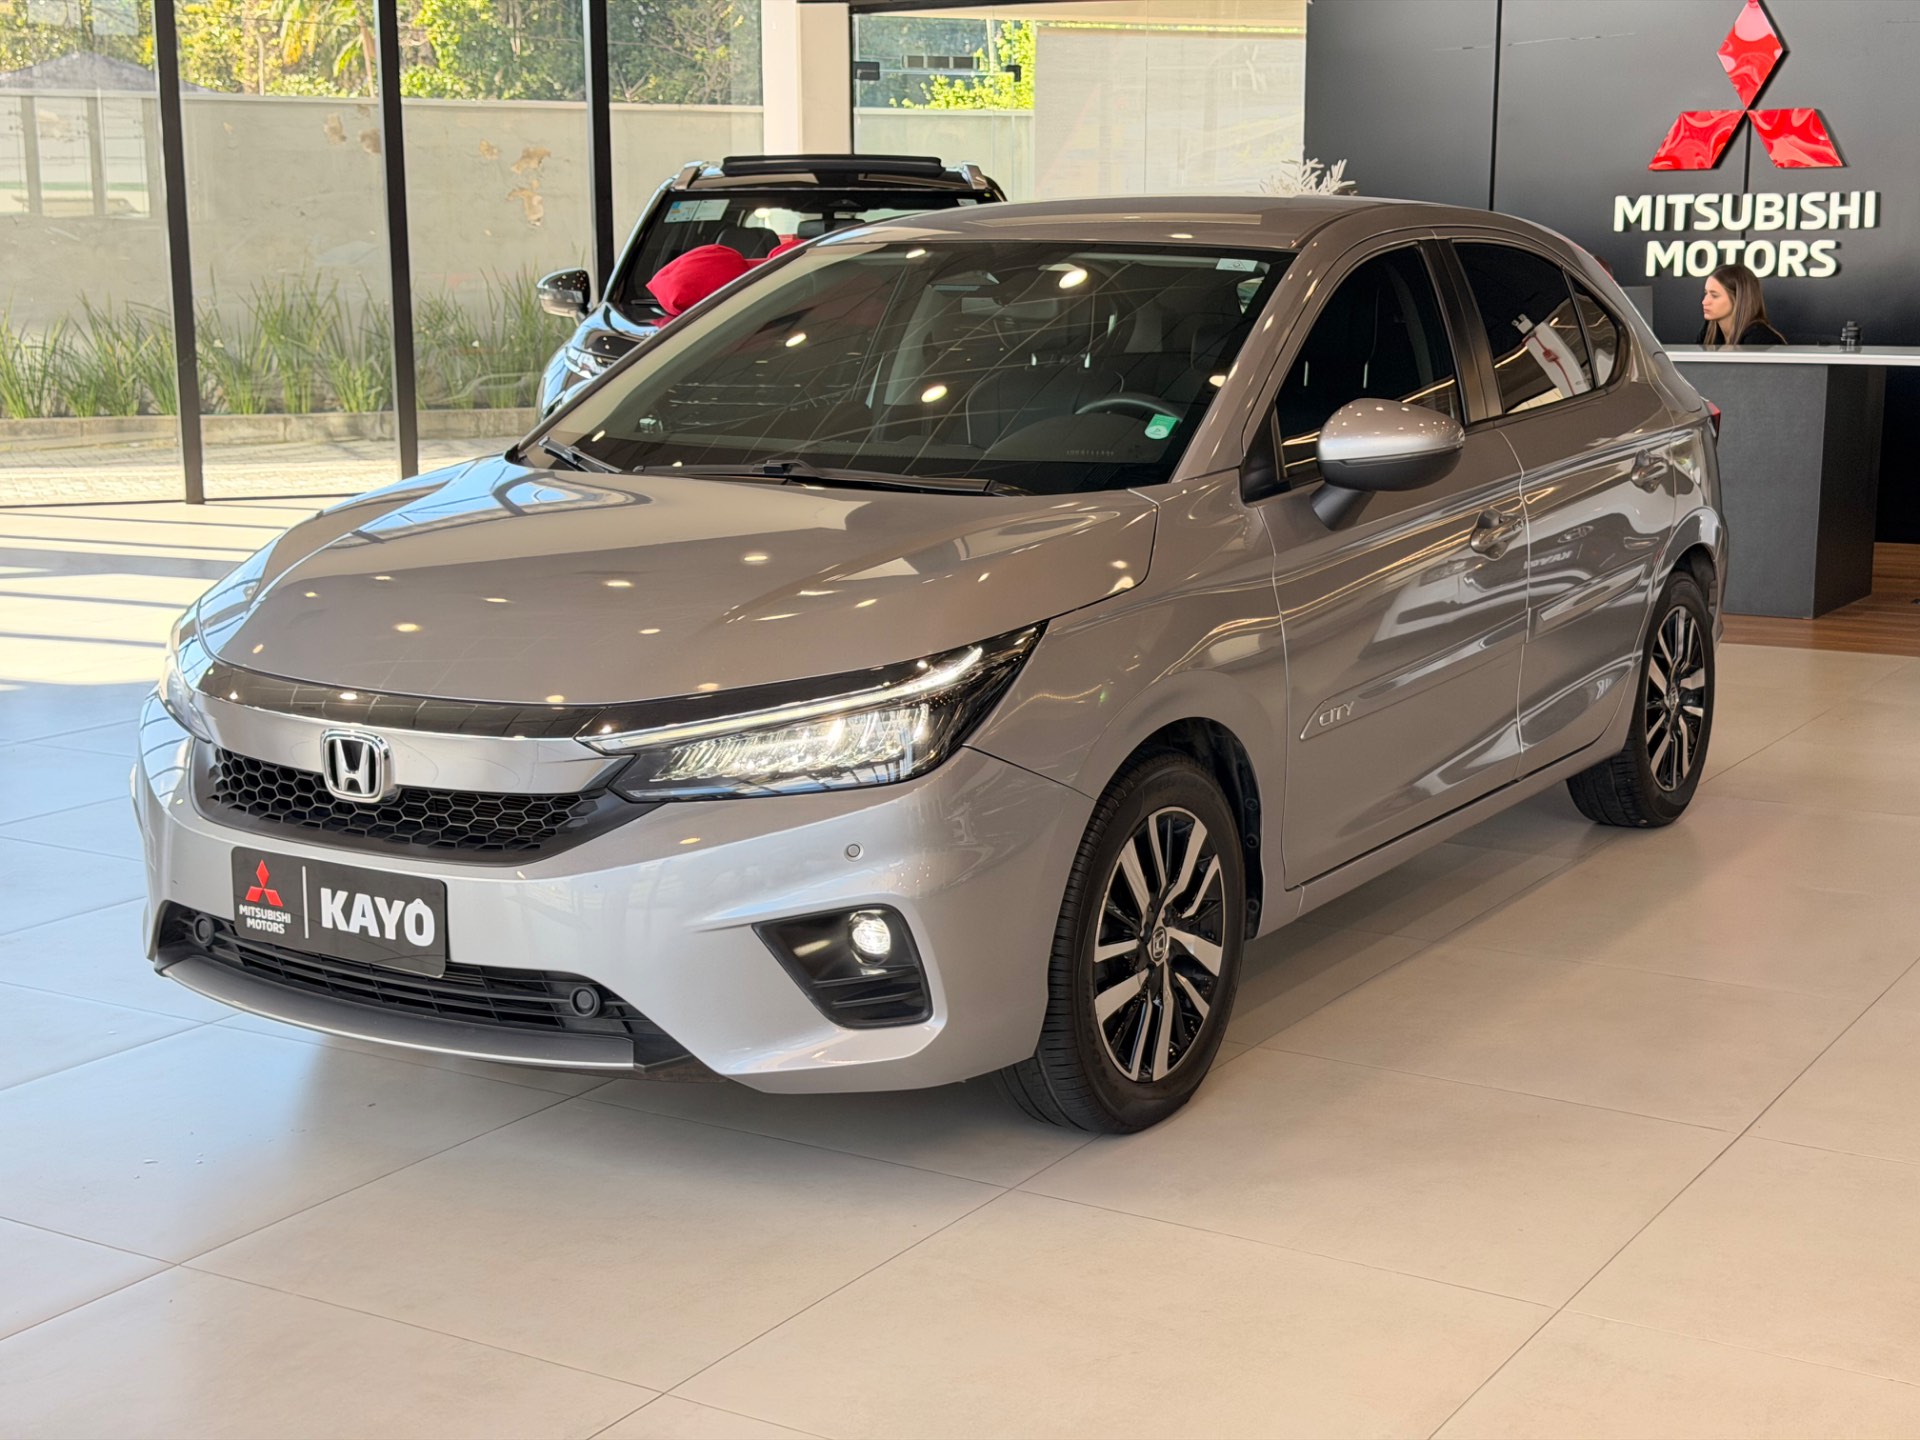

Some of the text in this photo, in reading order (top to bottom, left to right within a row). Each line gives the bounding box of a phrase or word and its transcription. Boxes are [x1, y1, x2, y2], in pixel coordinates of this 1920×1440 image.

[1613, 190, 1876, 232] MITSUBISHI
[1645, 239, 1838, 278] MOTORS
[1319, 701, 1354, 726] CITY
[238, 903, 292, 924] MITSUBISHI
[246, 917, 286, 935] MOTORS
[320, 887, 435, 947] KAYÔ
